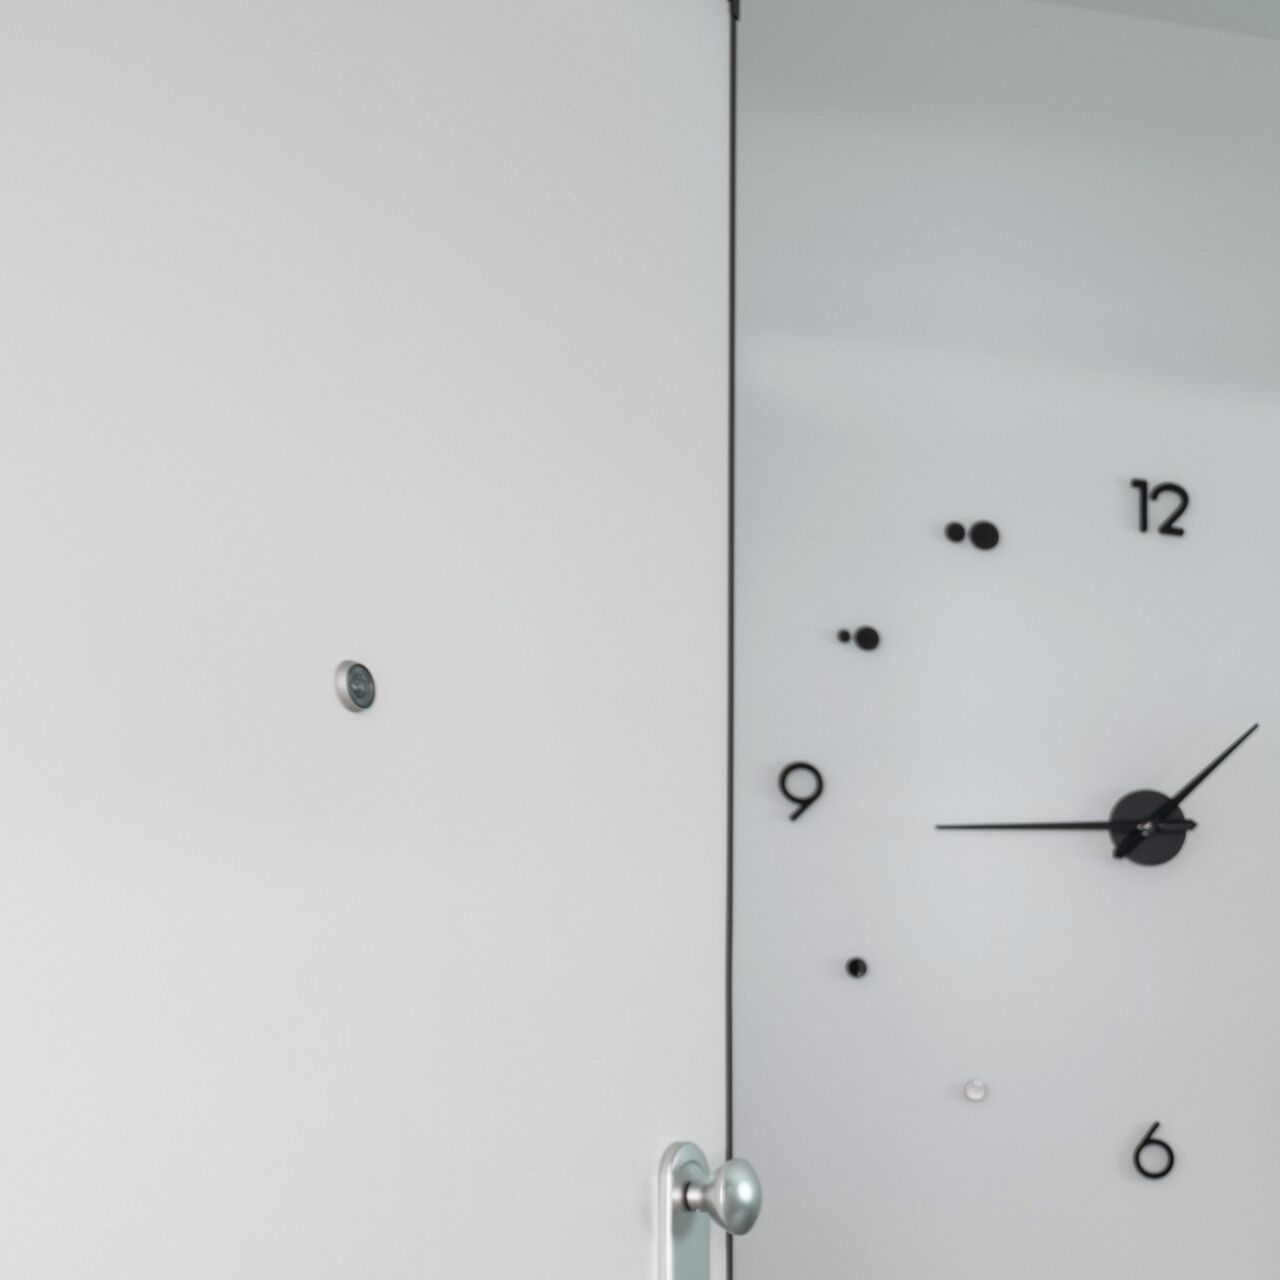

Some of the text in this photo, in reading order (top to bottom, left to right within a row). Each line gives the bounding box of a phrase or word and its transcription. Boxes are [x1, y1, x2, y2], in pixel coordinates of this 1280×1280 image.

[1130, 479, 1190, 537] 12
[778, 762, 824, 821] 9
[1133, 1121, 1175, 1180] 6
